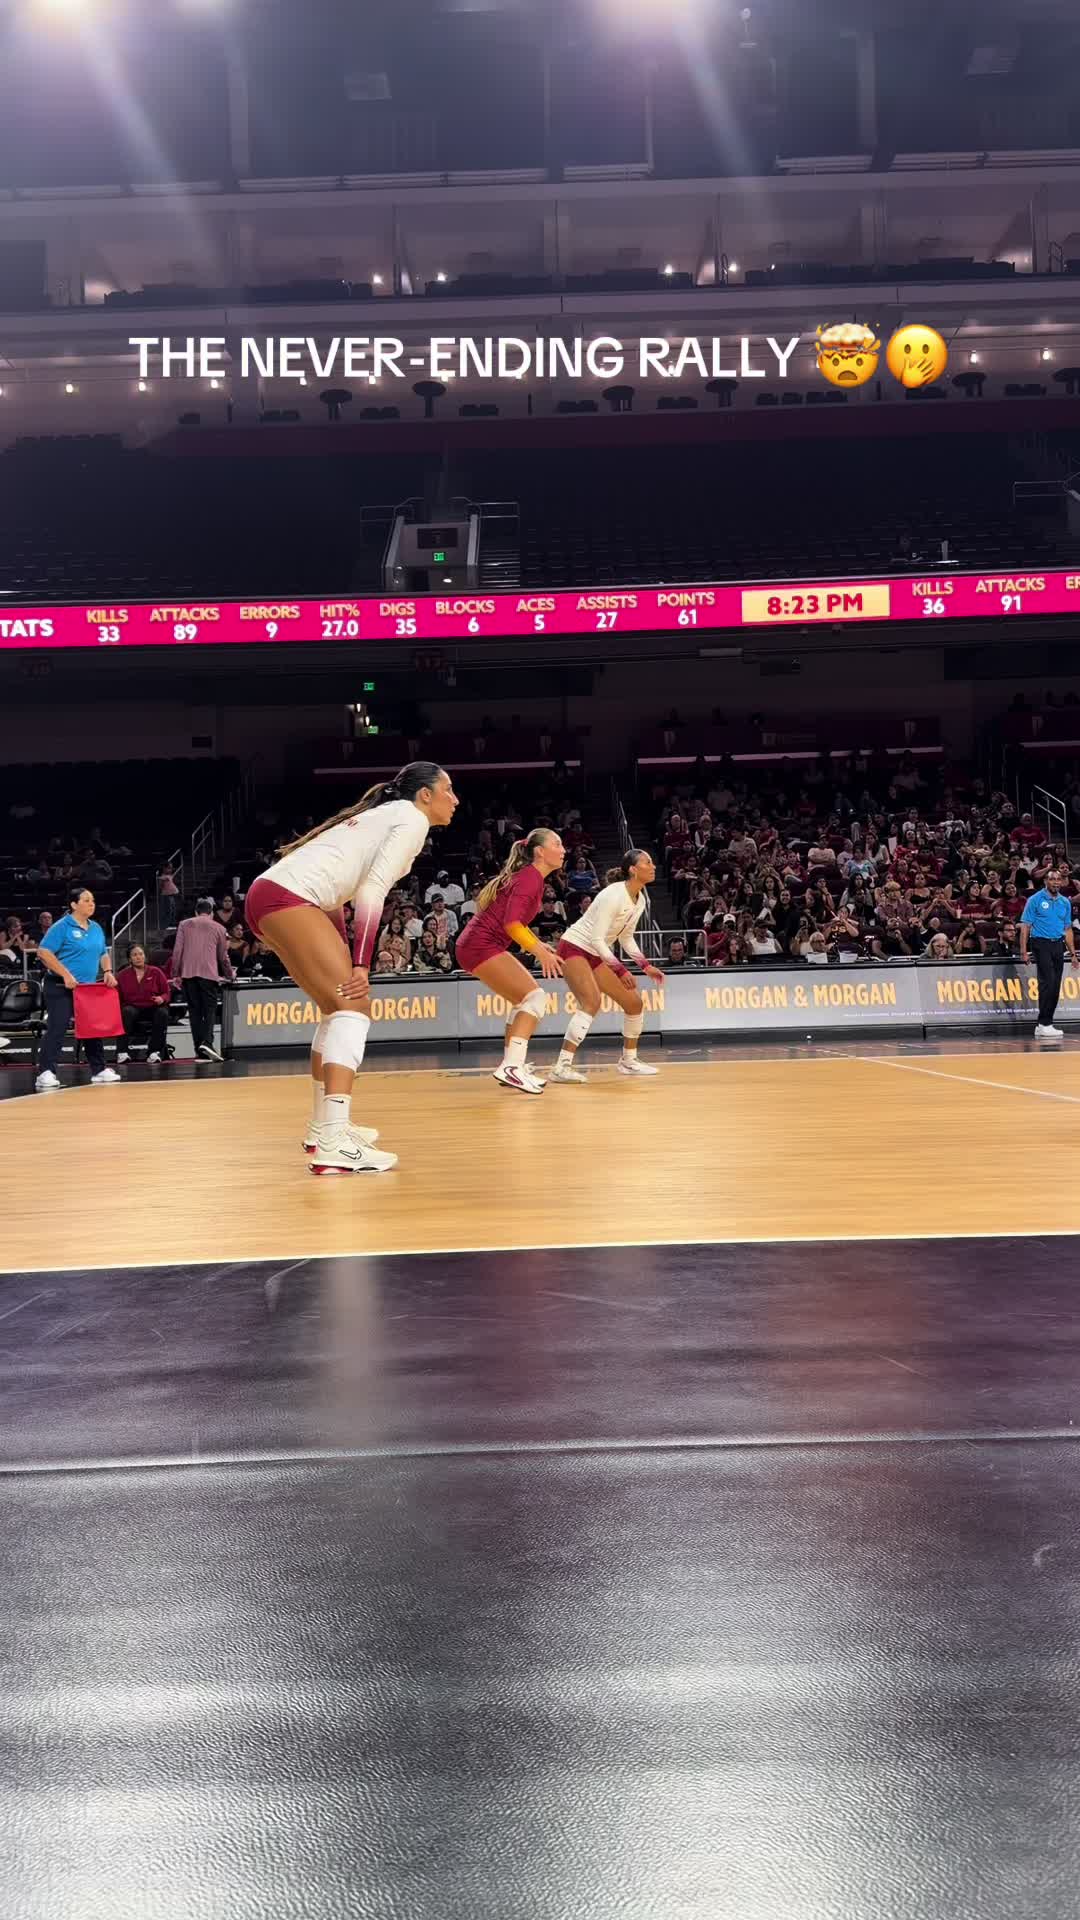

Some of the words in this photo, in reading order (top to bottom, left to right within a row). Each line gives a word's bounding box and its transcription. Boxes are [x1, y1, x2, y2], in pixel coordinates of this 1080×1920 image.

[912, 581, 953, 596] KILLS
[975, 577, 1046, 593] ATTACKS
[86, 609, 128, 624] KILLS
[150, 607, 220, 622] ATTACKS
[239, 605, 300, 620] ERRORS
[319, 603, 360, 618] HIT%
[380, 602, 416, 616] DIGS
[435, 599, 495, 614] BLOCKS
[516, 597, 555, 612] ACES
[576, 594, 638, 610] ASSISTS
[657, 591, 715, 607] POINTS
[767, 594, 820, 615] 8:23
[826, 592, 863, 613] PM
[922, 598, 945, 615] 36
[1000, 594, 1021, 612] 91
[97, 626, 120, 643] 33
[174, 624, 198, 641] 89
[266, 621, 279, 639] 9
[322, 619, 359, 637] 27.0
[396, 618, 416, 635] 35
[468, 616, 479, 633] 6
[534, 614, 545, 631] 5
[596, 611, 618, 629] 27
[678, 608, 697, 626] 61
[706, 985, 788, 1009] MORGAN
[795, 986, 809, 1008] &
[813, 983, 897, 1006] MORGAN
[937, 979, 1022, 1003] MORGAN
[370, 996, 436, 1020] ORGAN
